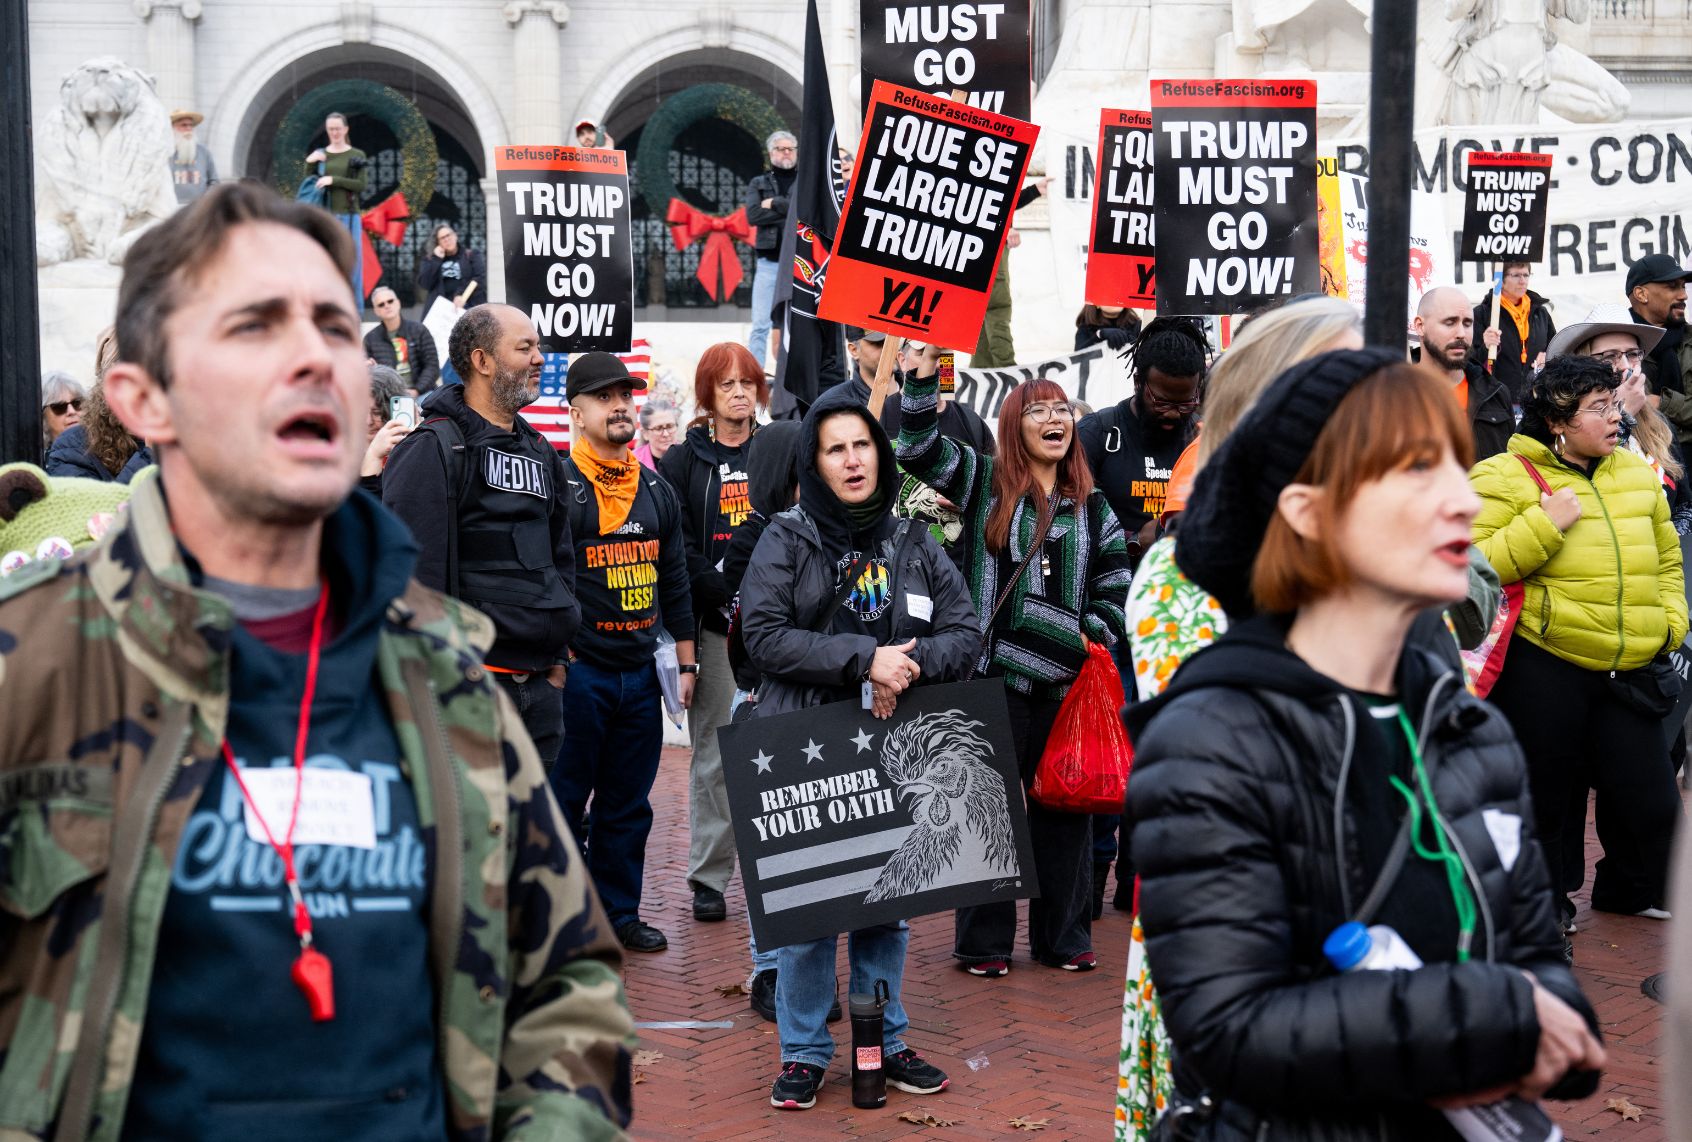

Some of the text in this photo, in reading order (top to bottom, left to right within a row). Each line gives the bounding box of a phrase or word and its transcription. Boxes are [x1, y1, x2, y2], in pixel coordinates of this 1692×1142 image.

[885, 3, 1004, 43] MUST
[914, 47, 975, 86] GO
[1162, 83, 1304, 99] RefuseFascism.org
[894, 91, 1015, 137] RefuseFascism.org
[506, 148, 618, 167] RefuseFascism.org
[877, 115, 966, 170] ¡QUE
[968, 137, 1018, 184] SE
[1162, 121, 1308, 159] TRUMP
[506, 182, 624, 218] TRUMP
[863, 159, 1004, 231] LARGUE
[1179, 166, 1293, 205] MUST
[1472, 171, 1545, 191] TRUMP
[1476, 193, 1536, 212] MUST
[523, 222, 615, 258] MUST
[860, 208, 984, 273] TRUMP
[1207, 211, 1268, 250] GO
[1489, 213, 1519, 234] GO
[1475, 235, 1532, 254] NOW!
[546, 263, 595, 297] GO
[1185, 257, 1294, 296] NOW!
[530, 303, 615, 338] NOW!
[878, 276, 943, 326] YA!
[488, 452, 543, 494] MEDIA
[621, 586, 653, 611] LESS!
[760, 768, 880, 813] REMEMBER
[752, 788, 895, 841] YOUR OATH
